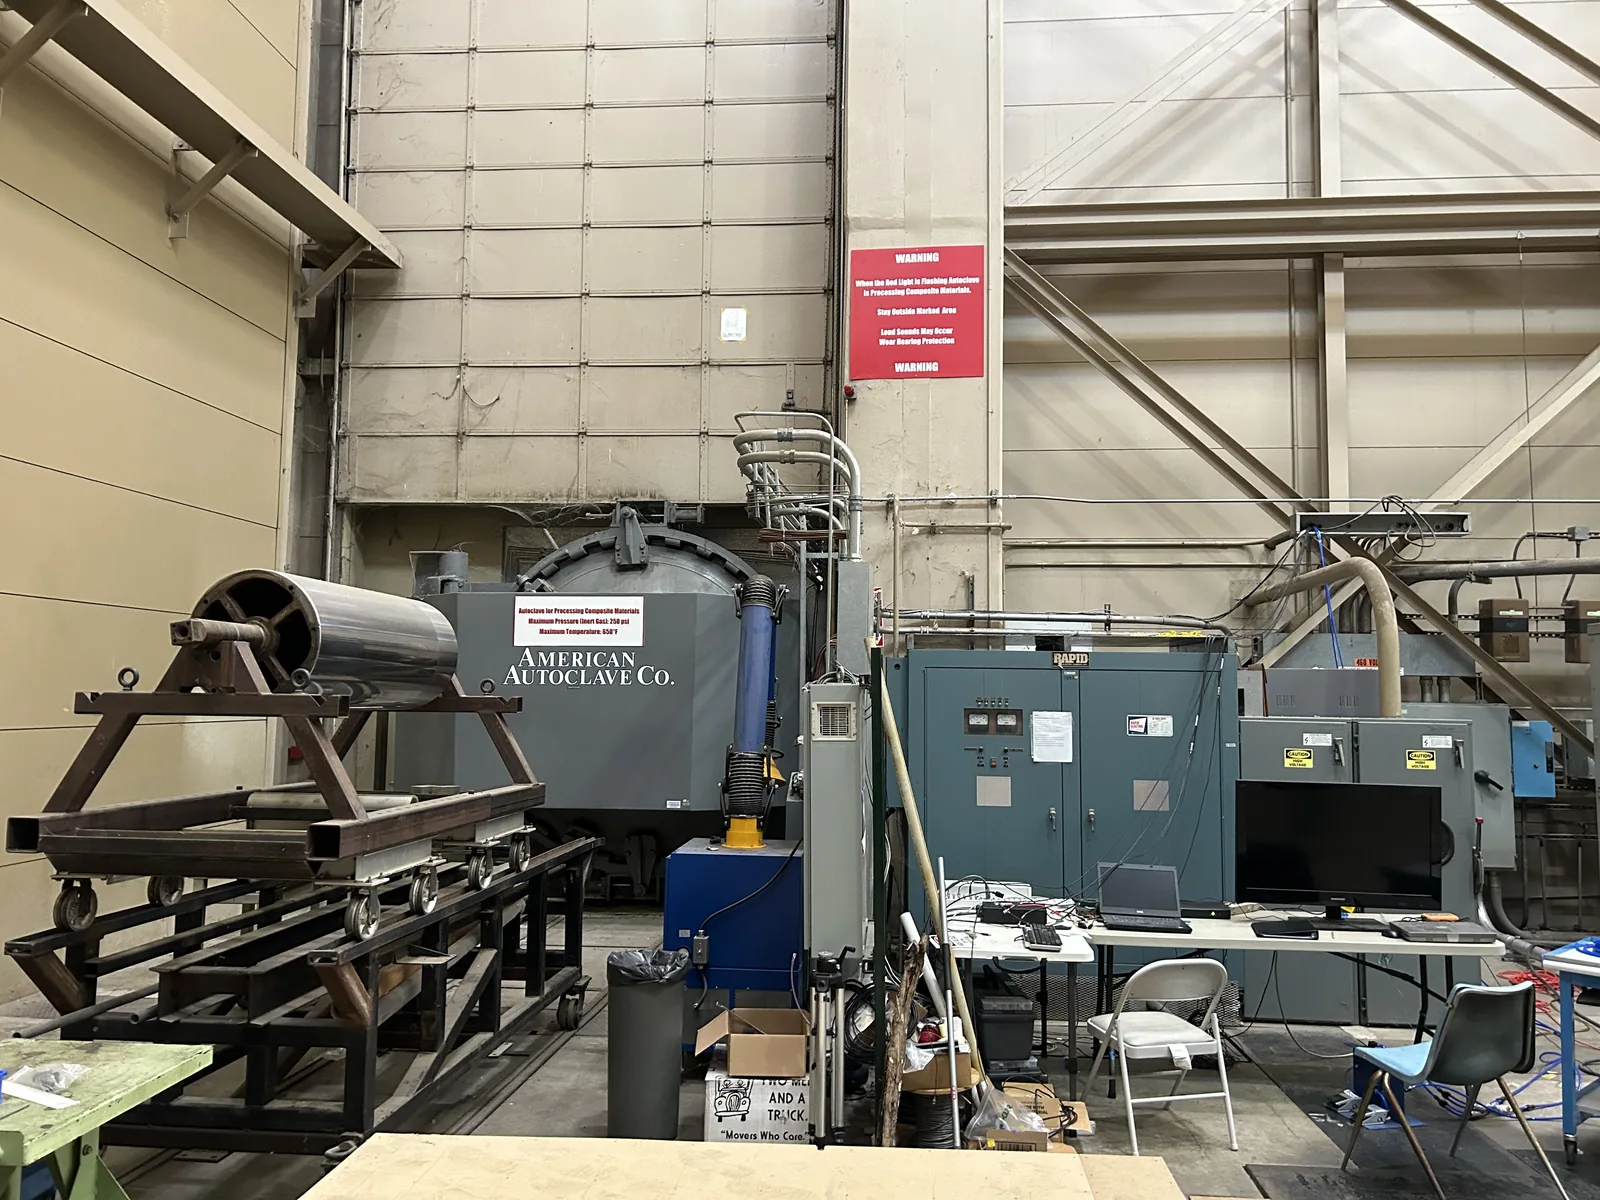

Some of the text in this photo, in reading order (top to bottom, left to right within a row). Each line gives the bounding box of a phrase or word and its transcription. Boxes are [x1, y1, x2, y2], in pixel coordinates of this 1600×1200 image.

[895, 252, 940, 264] WARNING
[855, 280, 873, 288] When
[874, 279, 885, 287] the
[886, 279, 898, 287] Red
[898, 278, 914, 287] Light
[921, 277, 948, 286] Flashing
[948, 276, 980, 285] Autoclave
[870, 288, 905, 297] Processing
[906, 287, 939, 296] Composite
[940, 286, 972, 295] Materials.
[877, 306, 957, 317] Stay Outside Marked Area
[881, 327, 953, 336] Loud Sounds May Occur
[879, 337, 955, 346] Wear Hearing Protection
[894, 362, 939, 373] WARNING
[621, 618, 629, 626] psi
[566, 628, 602, 636] Temperature:
[518, 647, 636, 667] AMERICAN
[1053, 652, 1089, 666] RAPID
[1356, 658, 1379, 666] 460 VOL
[503, 665, 632, 685] AUTOCLAVE
[791, 1079, 810, 1087] ME
[769, 1092, 806, 1104] AND A
[760, 1131, 780, 1141] Who
